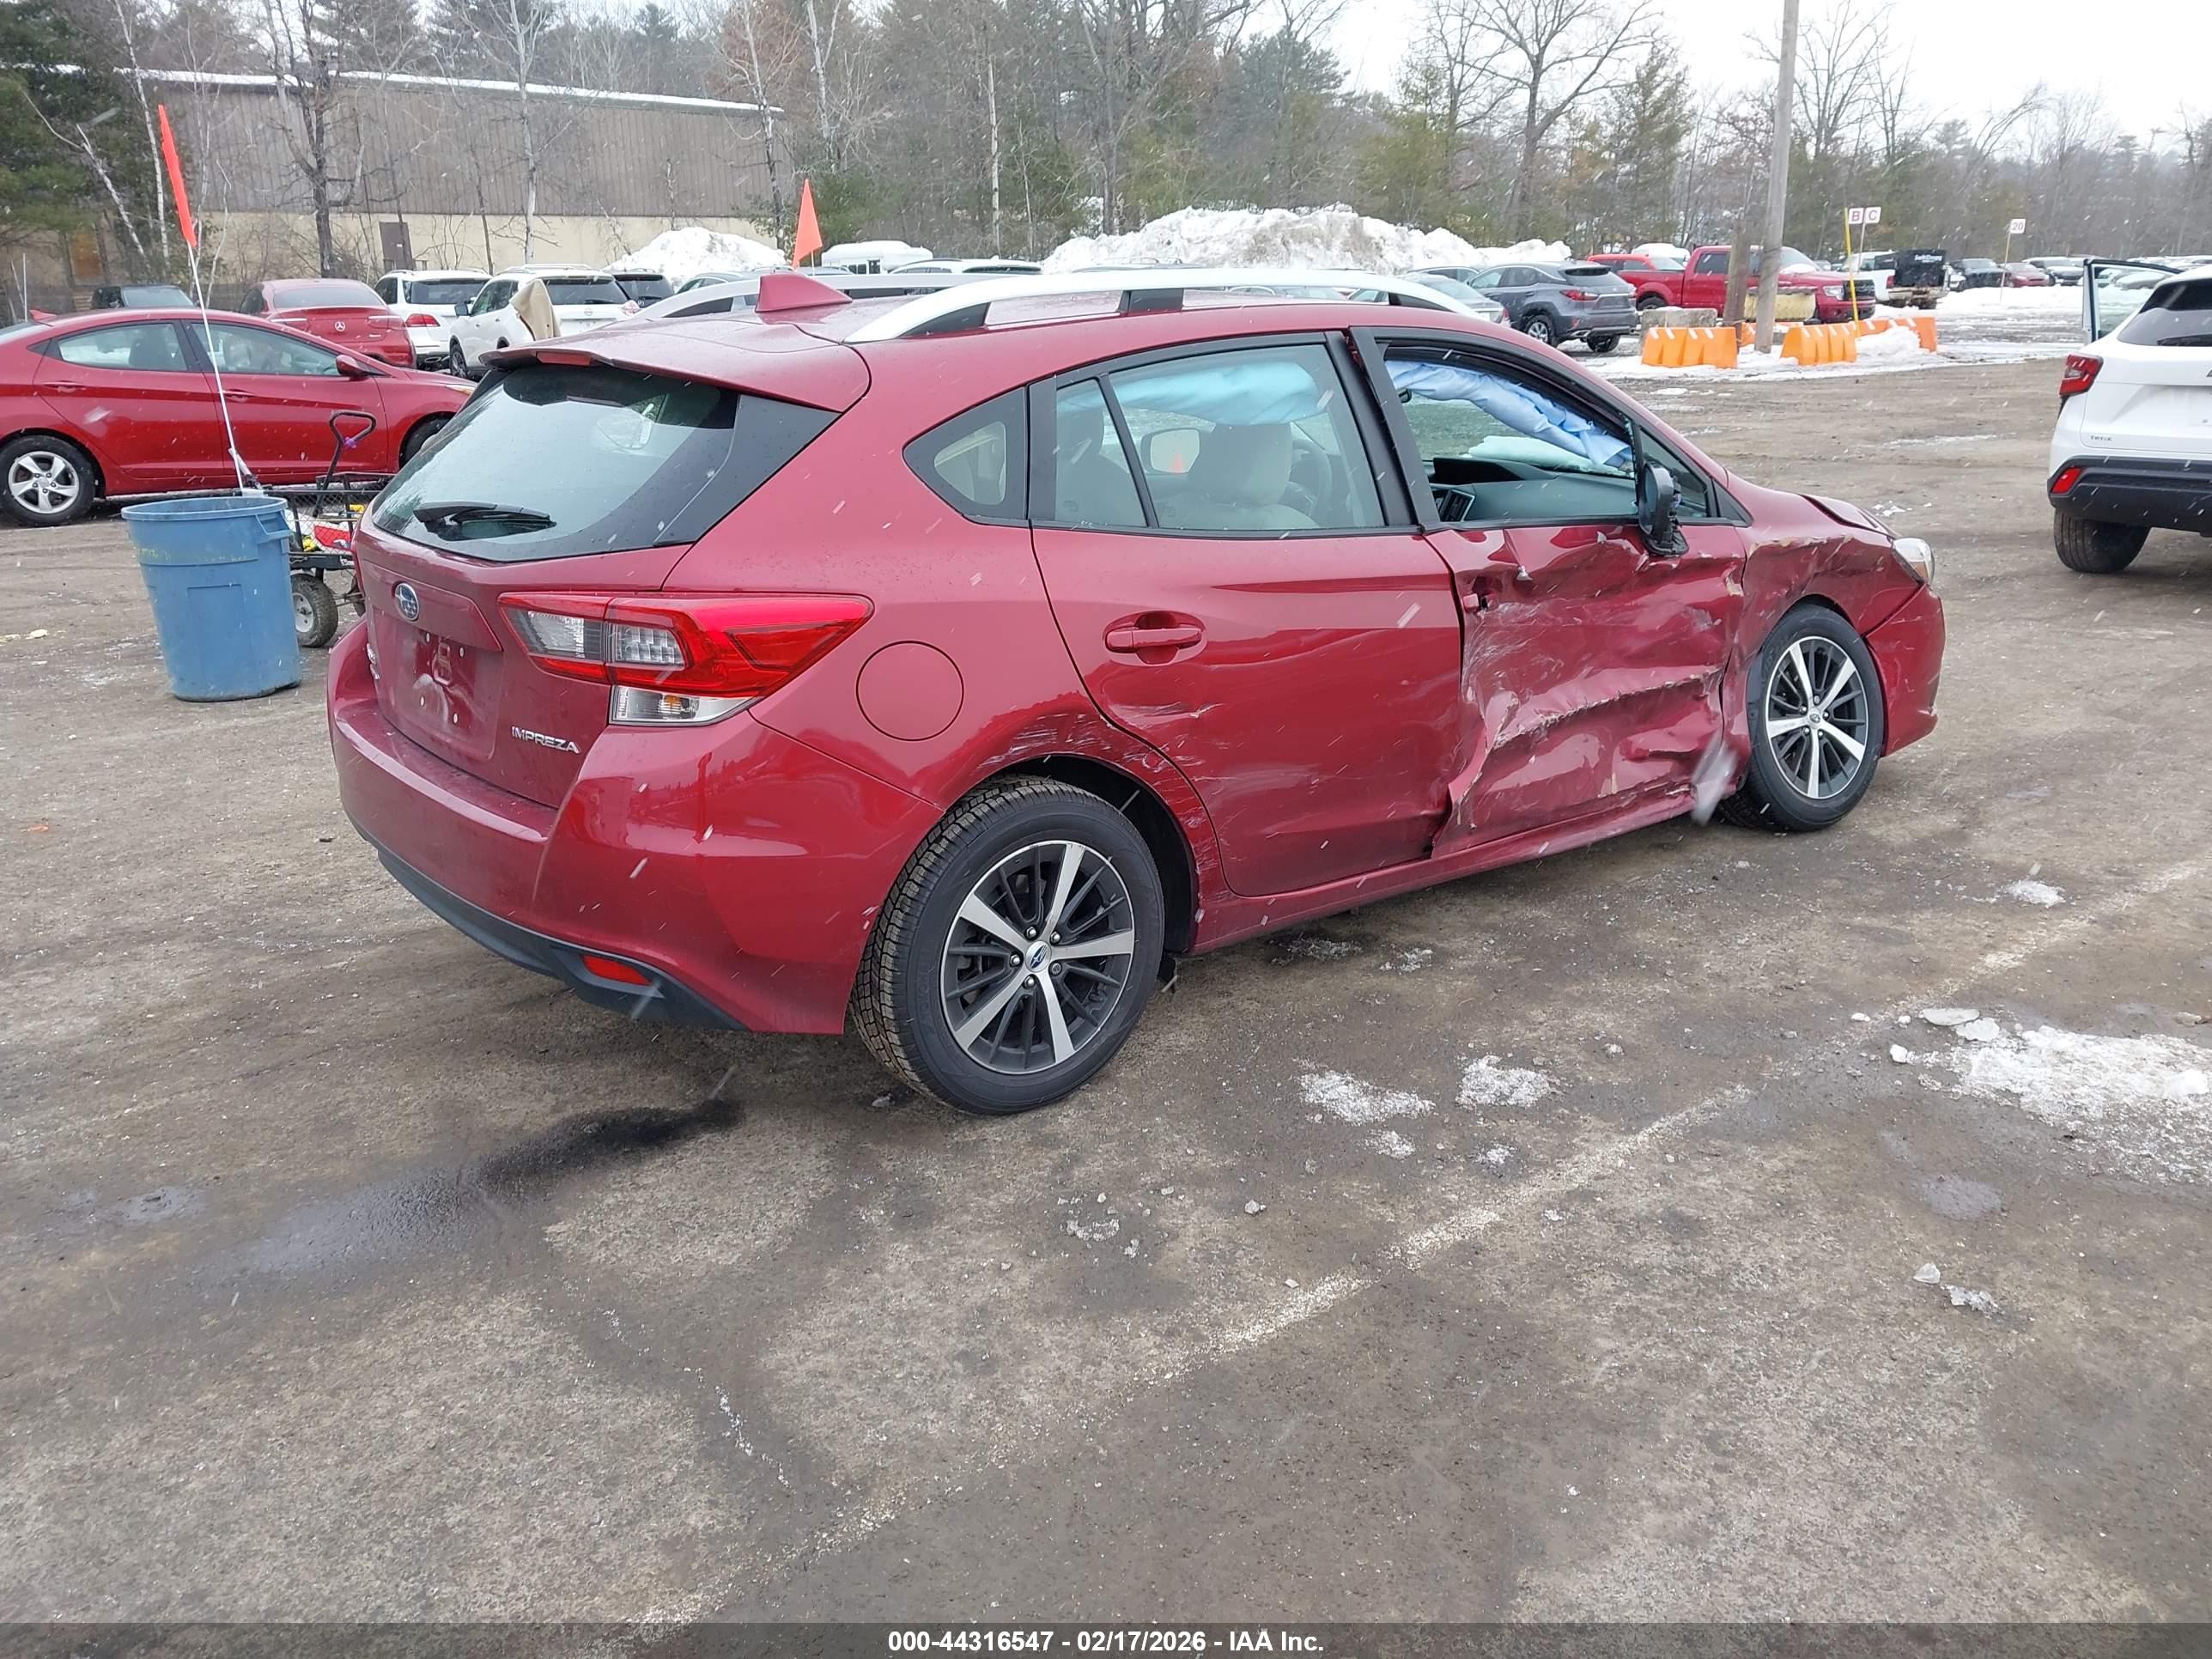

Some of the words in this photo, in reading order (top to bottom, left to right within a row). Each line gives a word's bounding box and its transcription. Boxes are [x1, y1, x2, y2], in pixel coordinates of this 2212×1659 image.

[1851, 210, 1861, 222] B
[1868, 210, 1877, 222] C
[2012, 222, 2024, 230] 20
[511, 726, 581, 754] IMPREZA
